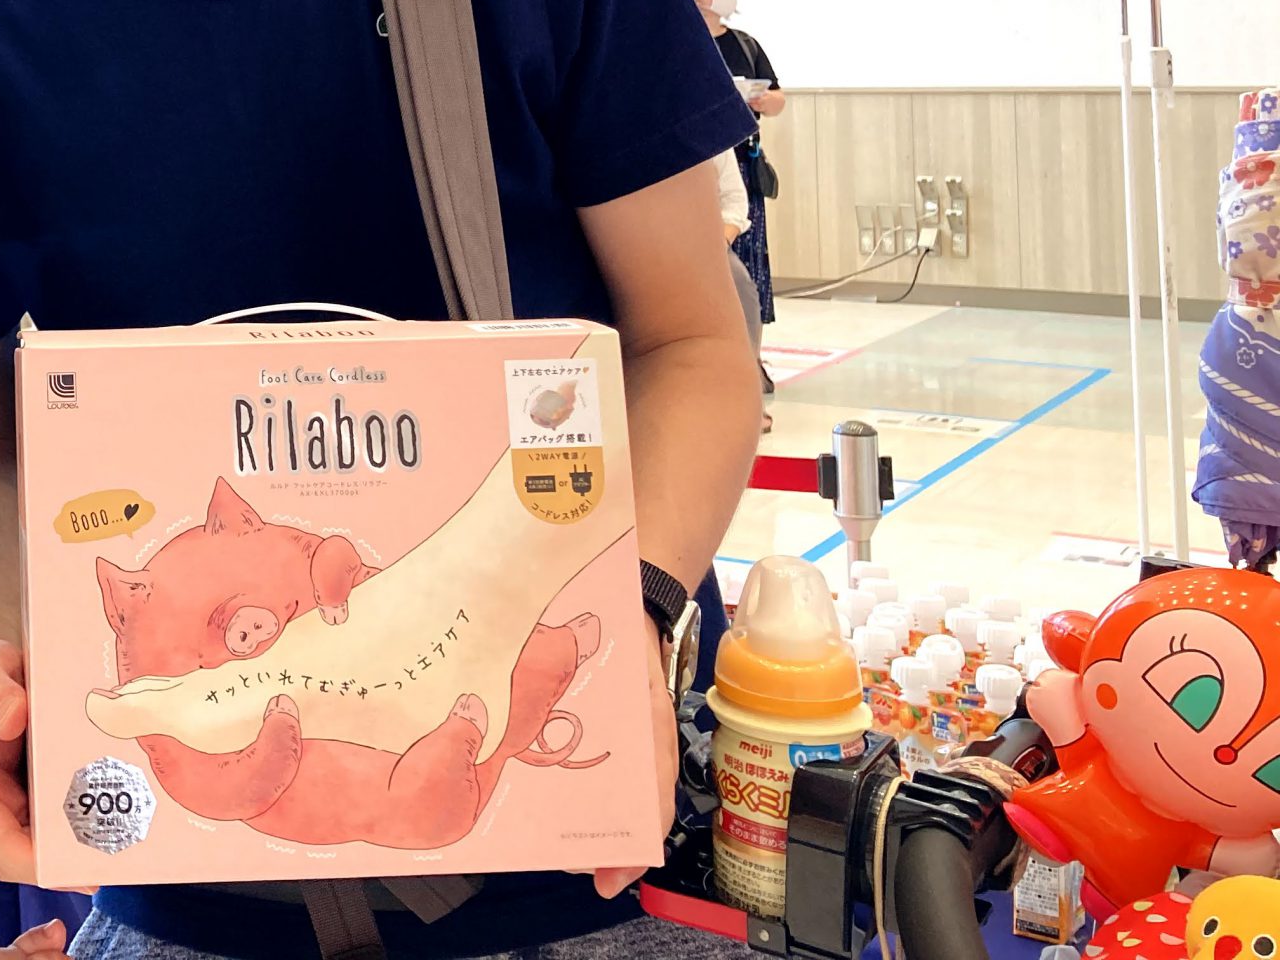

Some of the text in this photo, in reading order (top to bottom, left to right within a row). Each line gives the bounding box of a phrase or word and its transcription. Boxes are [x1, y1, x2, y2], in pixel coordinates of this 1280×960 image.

[261, 367, 385, 384] Foot Care Cordless
[235, 398, 418, 472] Rilaboo
[739, 740, 773, 759] meiji
[746, 762, 790, 783] ほほえみ
[78, 791, 133, 816] 900
